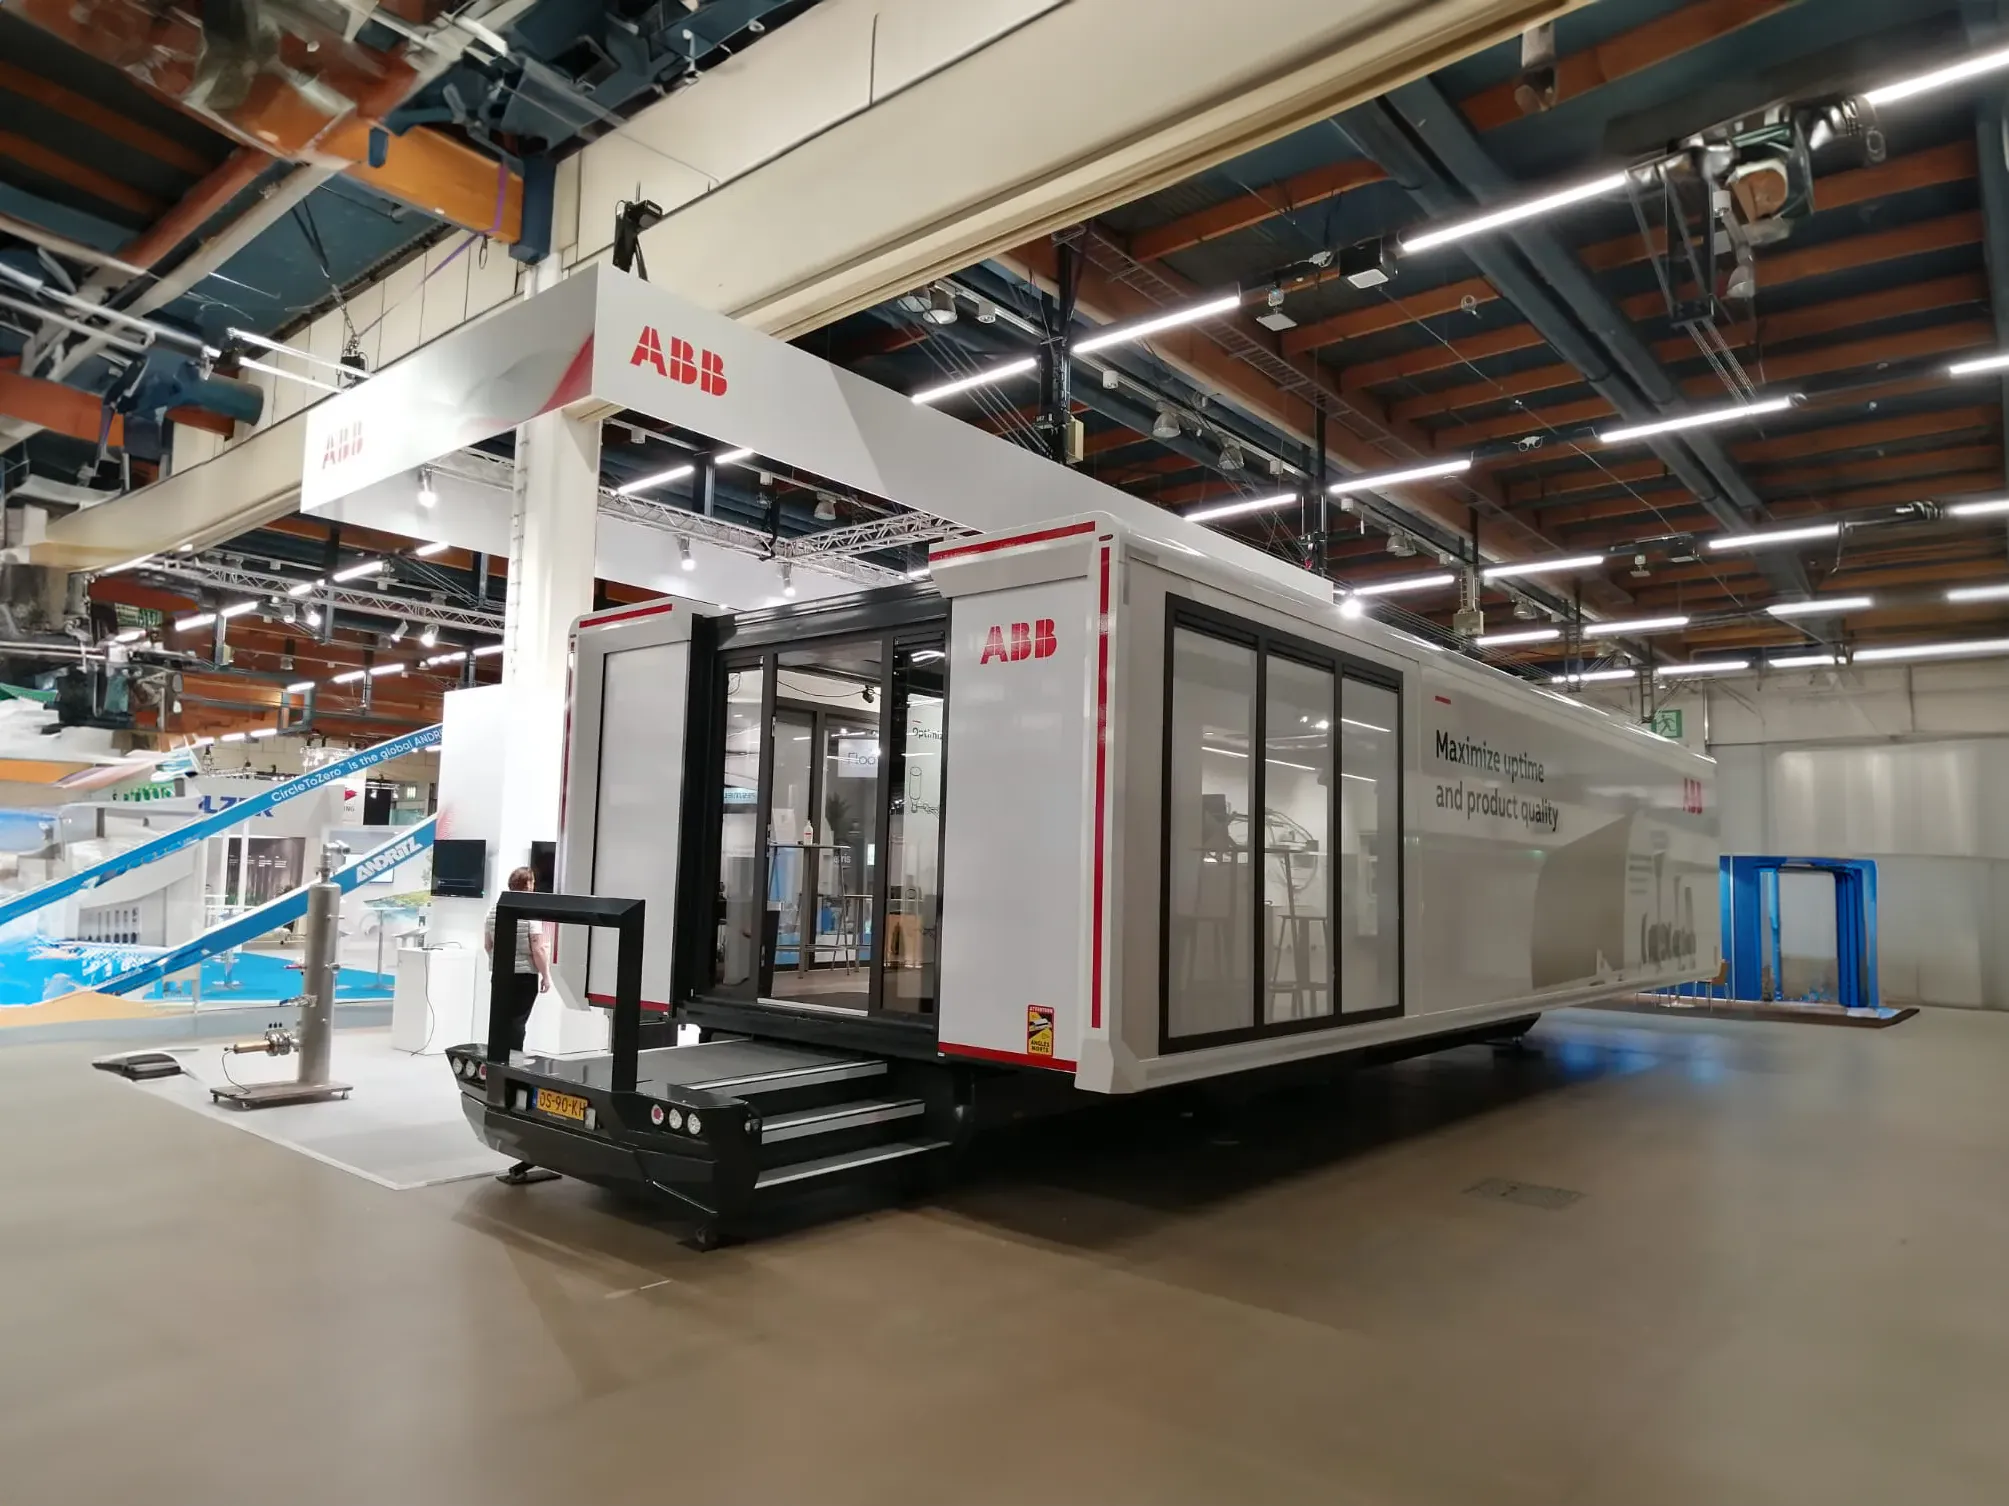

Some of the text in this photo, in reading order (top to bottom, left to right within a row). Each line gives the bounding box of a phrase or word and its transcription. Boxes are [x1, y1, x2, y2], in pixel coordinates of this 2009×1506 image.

[630, 325, 728, 396] ABB
[980, 618, 1058, 664] ABB
[350, 761, 359, 771] is
[360, 754, 379, 768] the
[381, 740, 413, 760] global
[1436, 729, 1544, 783] Maximize uptime
[1436, 781, 1559, 832] and product quality
